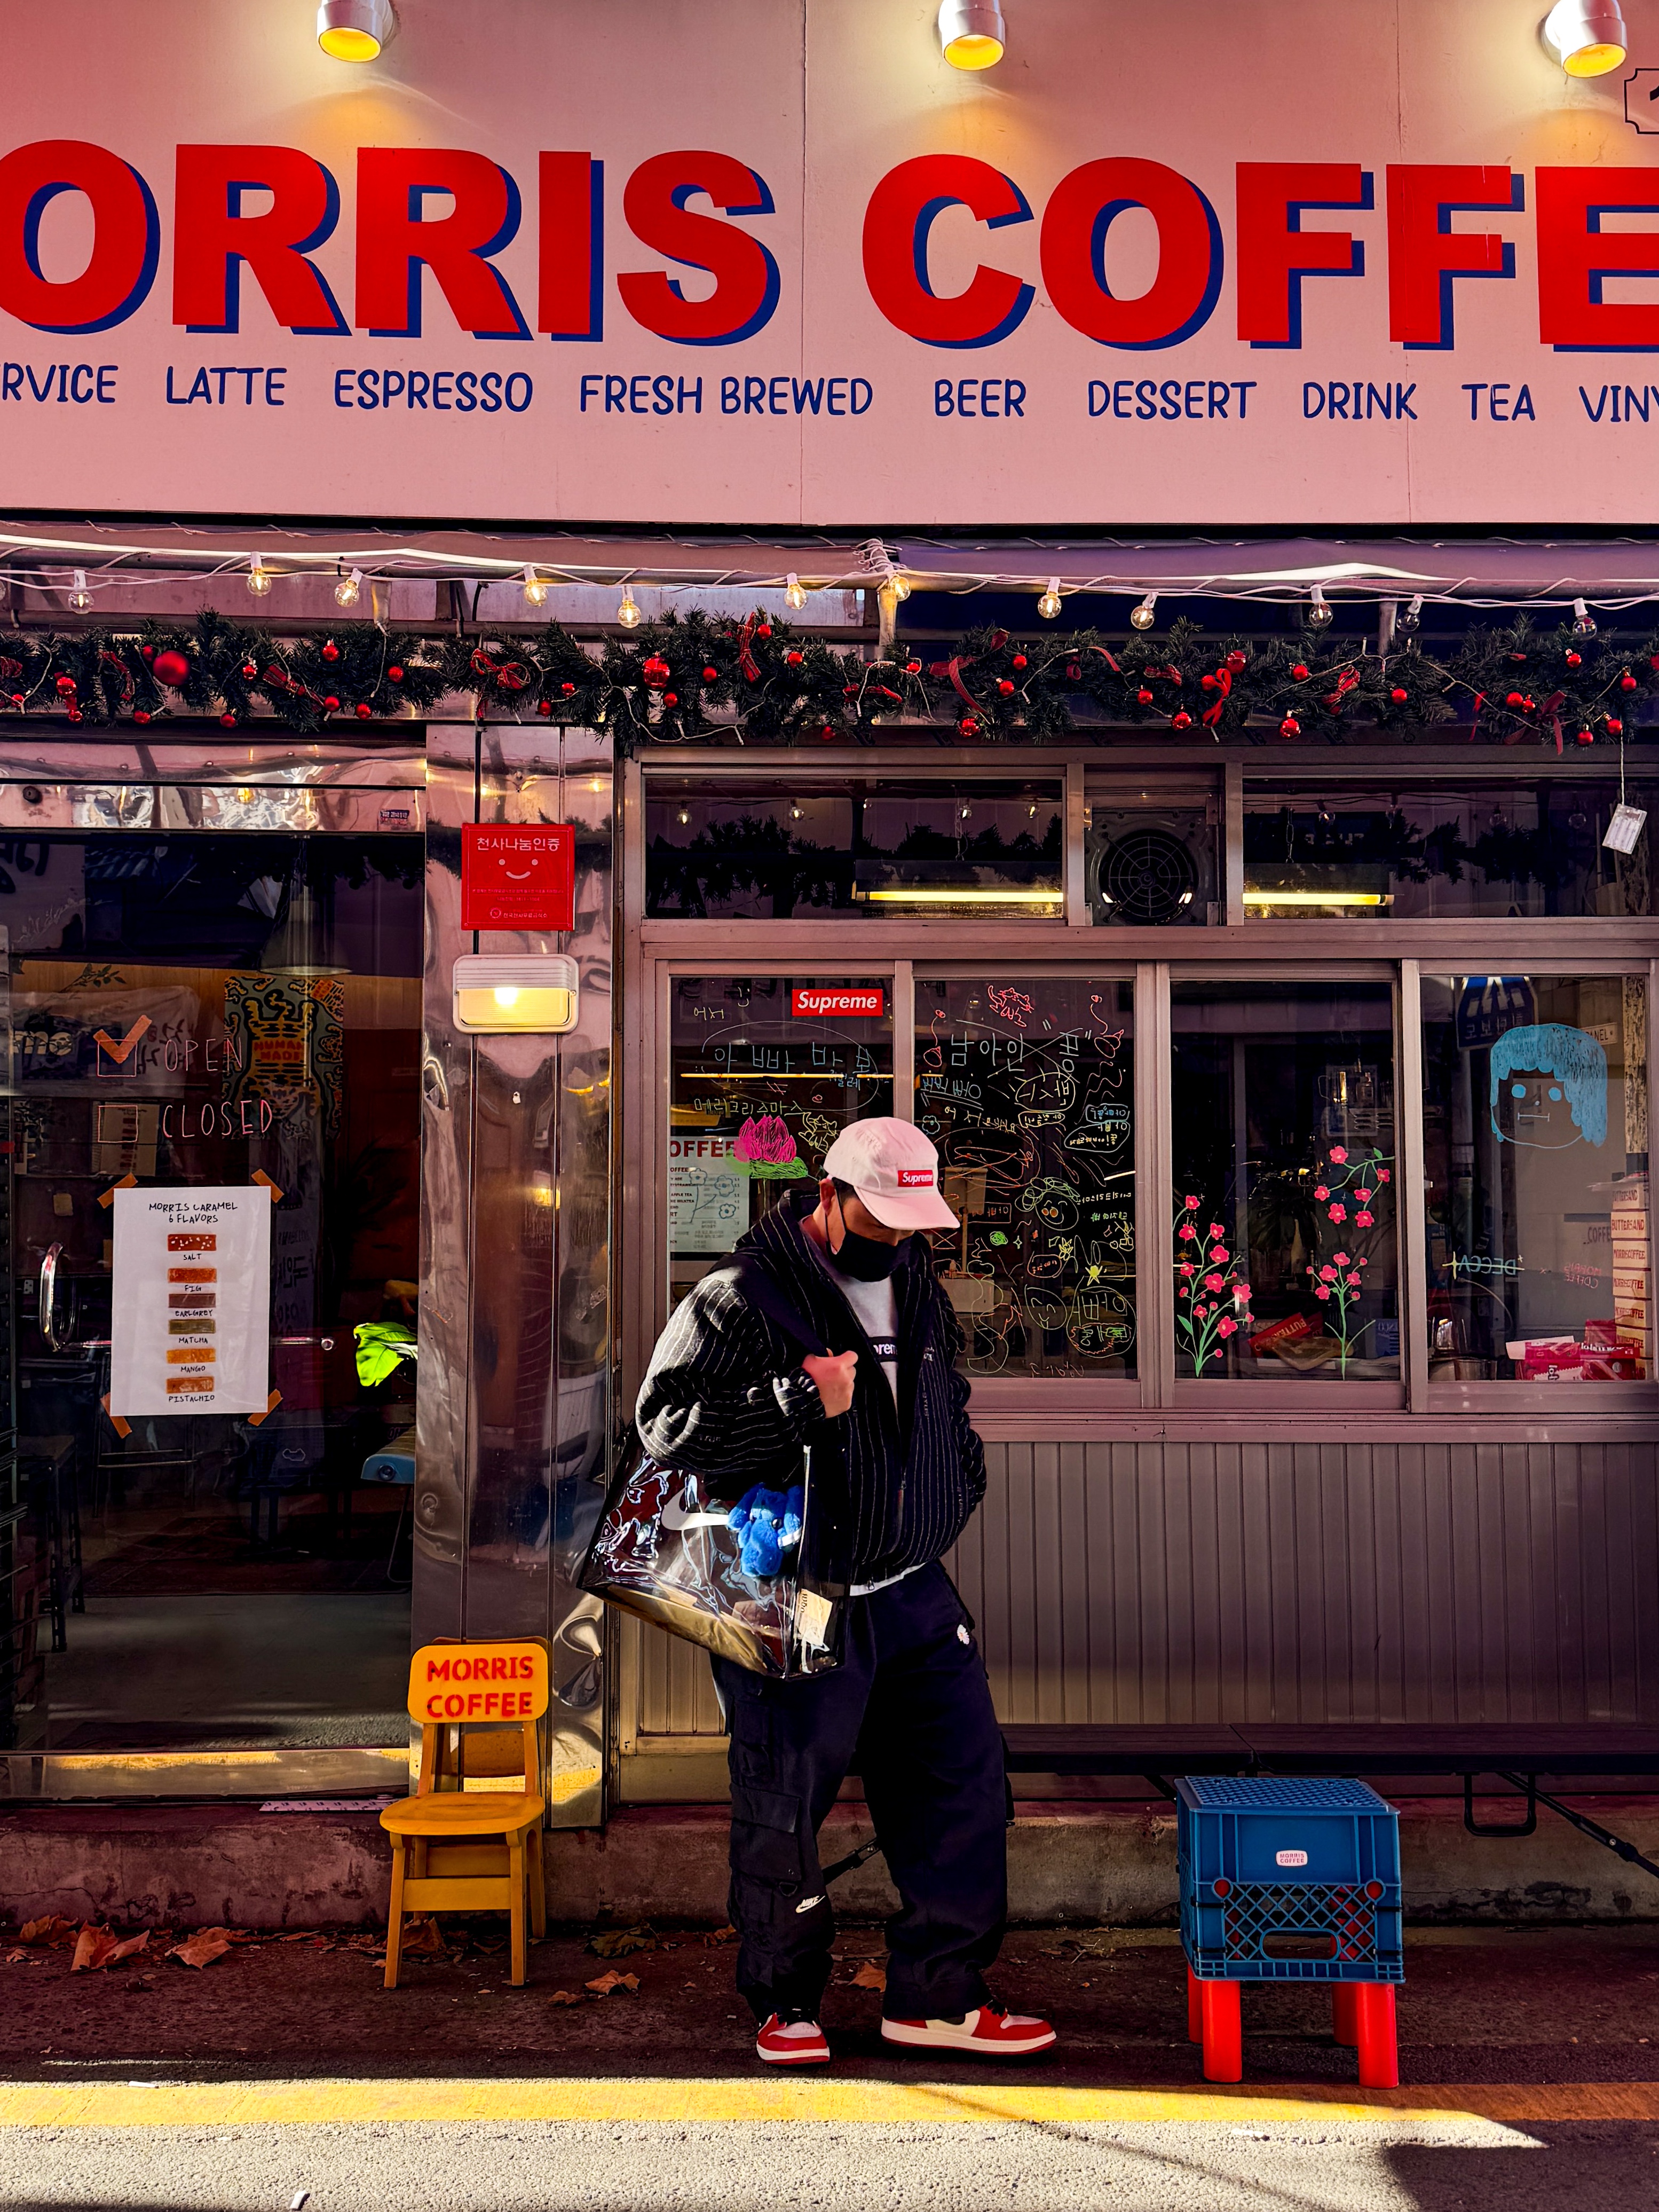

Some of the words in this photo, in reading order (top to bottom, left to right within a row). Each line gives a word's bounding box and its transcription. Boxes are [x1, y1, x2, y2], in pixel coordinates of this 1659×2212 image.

[0, 140, 780, 346] ORRIS
[3, 363, 118, 403] RVICE
[167, 366, 287, 405] LATTE
[335, 369, 532, 412] ESPRESSO
[581, 375, 702, 415] FRESH
[722, 376, 872, 415] BREWED
[935, 379, 1025, 416] BEER
[1089, 381, 1257, 420] DESSERT
[1304, 382, 1417, 420] DRINK
[1462, 384, 1535, 421] TEA
[477, 837, 560, 852] 천사나눔인증
[797, 991, 877, 1013] Supreme
[164, 1038, 242, 1072] OPEN
[260, 1051, 299, 1060] MADE
[694, 1098, 805, 1115] 메리크리스마스
[162, 1099, 273, 1138] CLOSED
[149, 1202, 189, 1212] MORRIS
[193, 1202, 238, 1211] CARAMEL
[169, 1214, 173, 1223] 6
[177, 1214, 218, 1223] FLAVORS
[428, 1656, 533, 1682] MORRIS
[427, 1692, 532, 1718] COFFEE
[801, 1895, 819, 1907] NIKE
